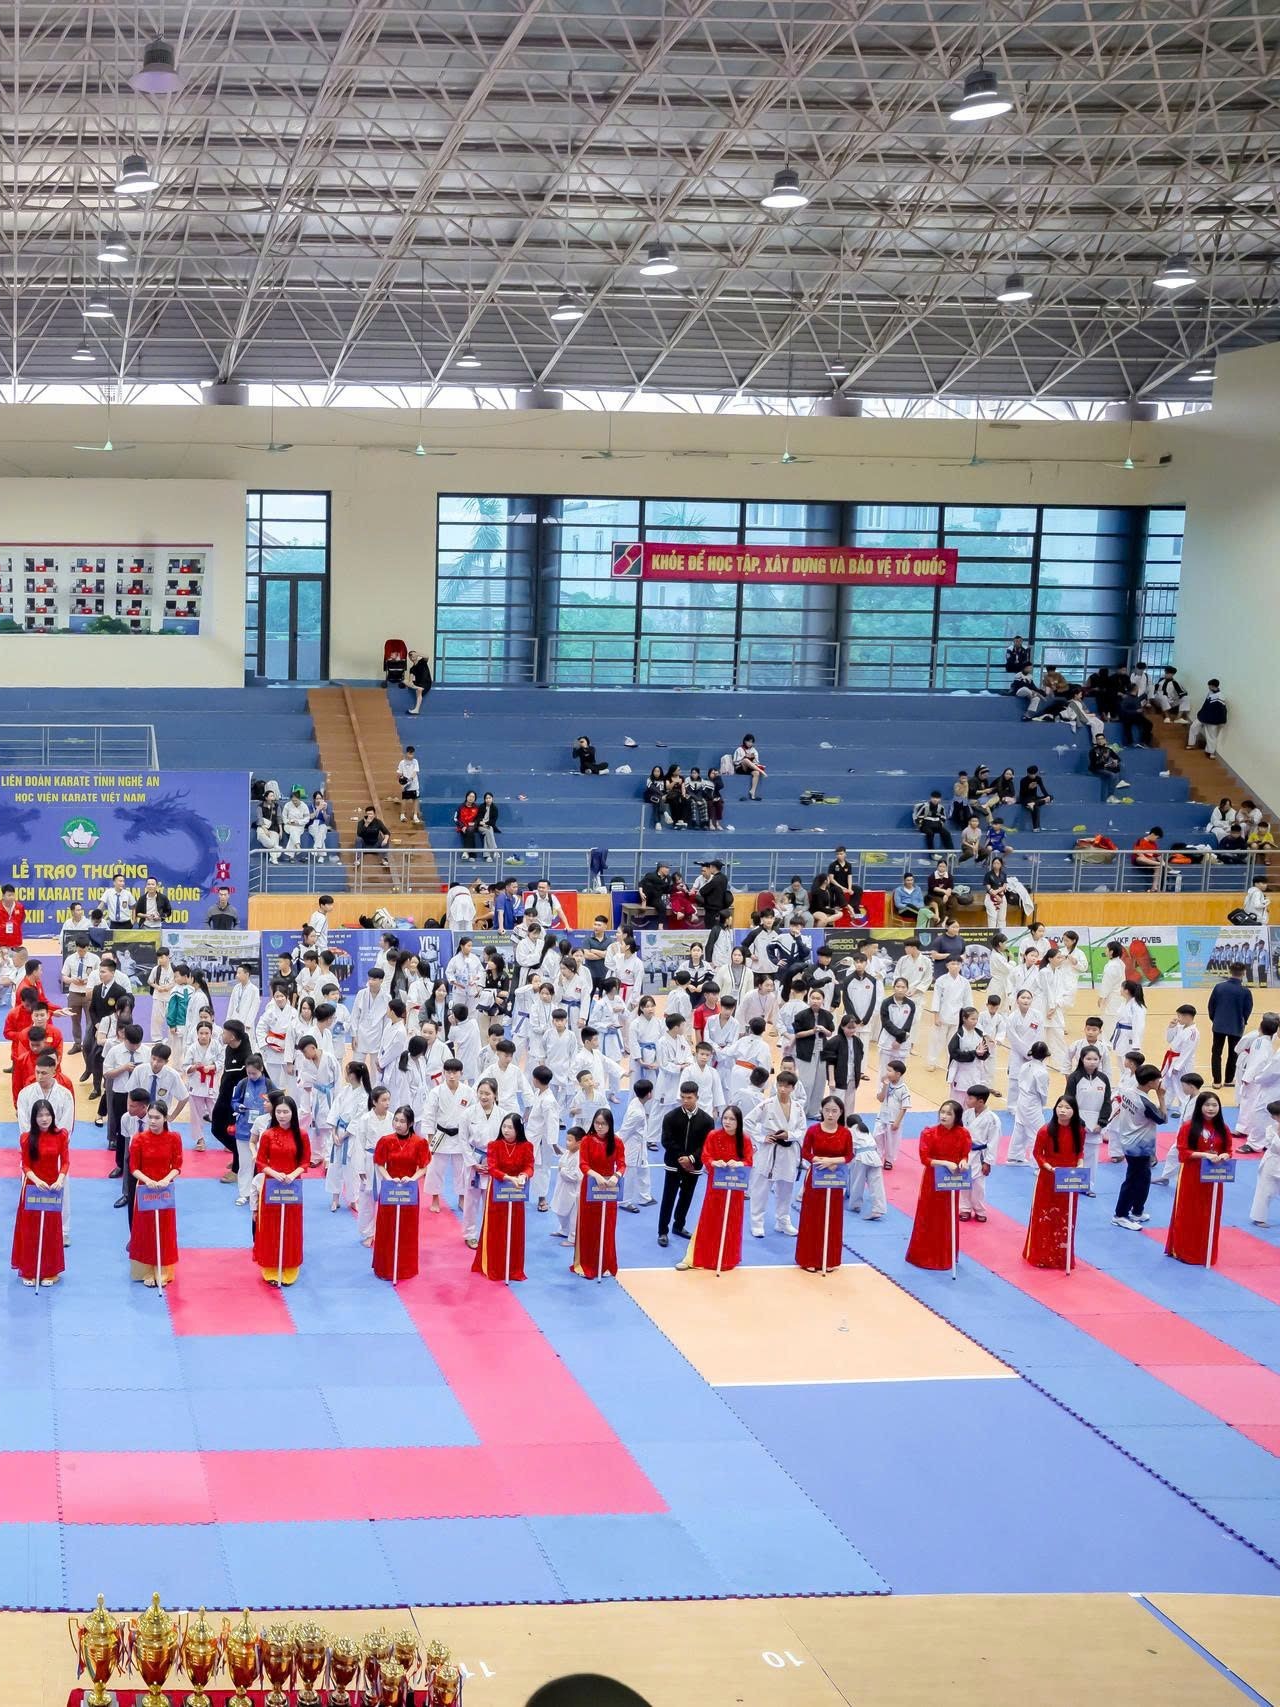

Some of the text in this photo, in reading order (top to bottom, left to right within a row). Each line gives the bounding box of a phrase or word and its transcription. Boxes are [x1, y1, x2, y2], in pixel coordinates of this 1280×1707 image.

[652, 549, 947, 578] KHỎE ĐỂ HỌC TẬP, XÂY DỰNG VÀ BẢO VỆ TỔ QUỐC
[1, 773, 22, 787] LIÊN
[54, 776, 90, 787] KARATE
[118, 774, 143, 790] NGHỆ
[146, 776, 160, 787] AN
[15, 792, 146, 804] HỌC VIỆN KARATE VIỆT NAM
[12, 858, 148, 880] LỄ TRAO THƯỞNG
[39, 887, 83, 901] KARATE
[168, 884, 200, 904] RỘNG
